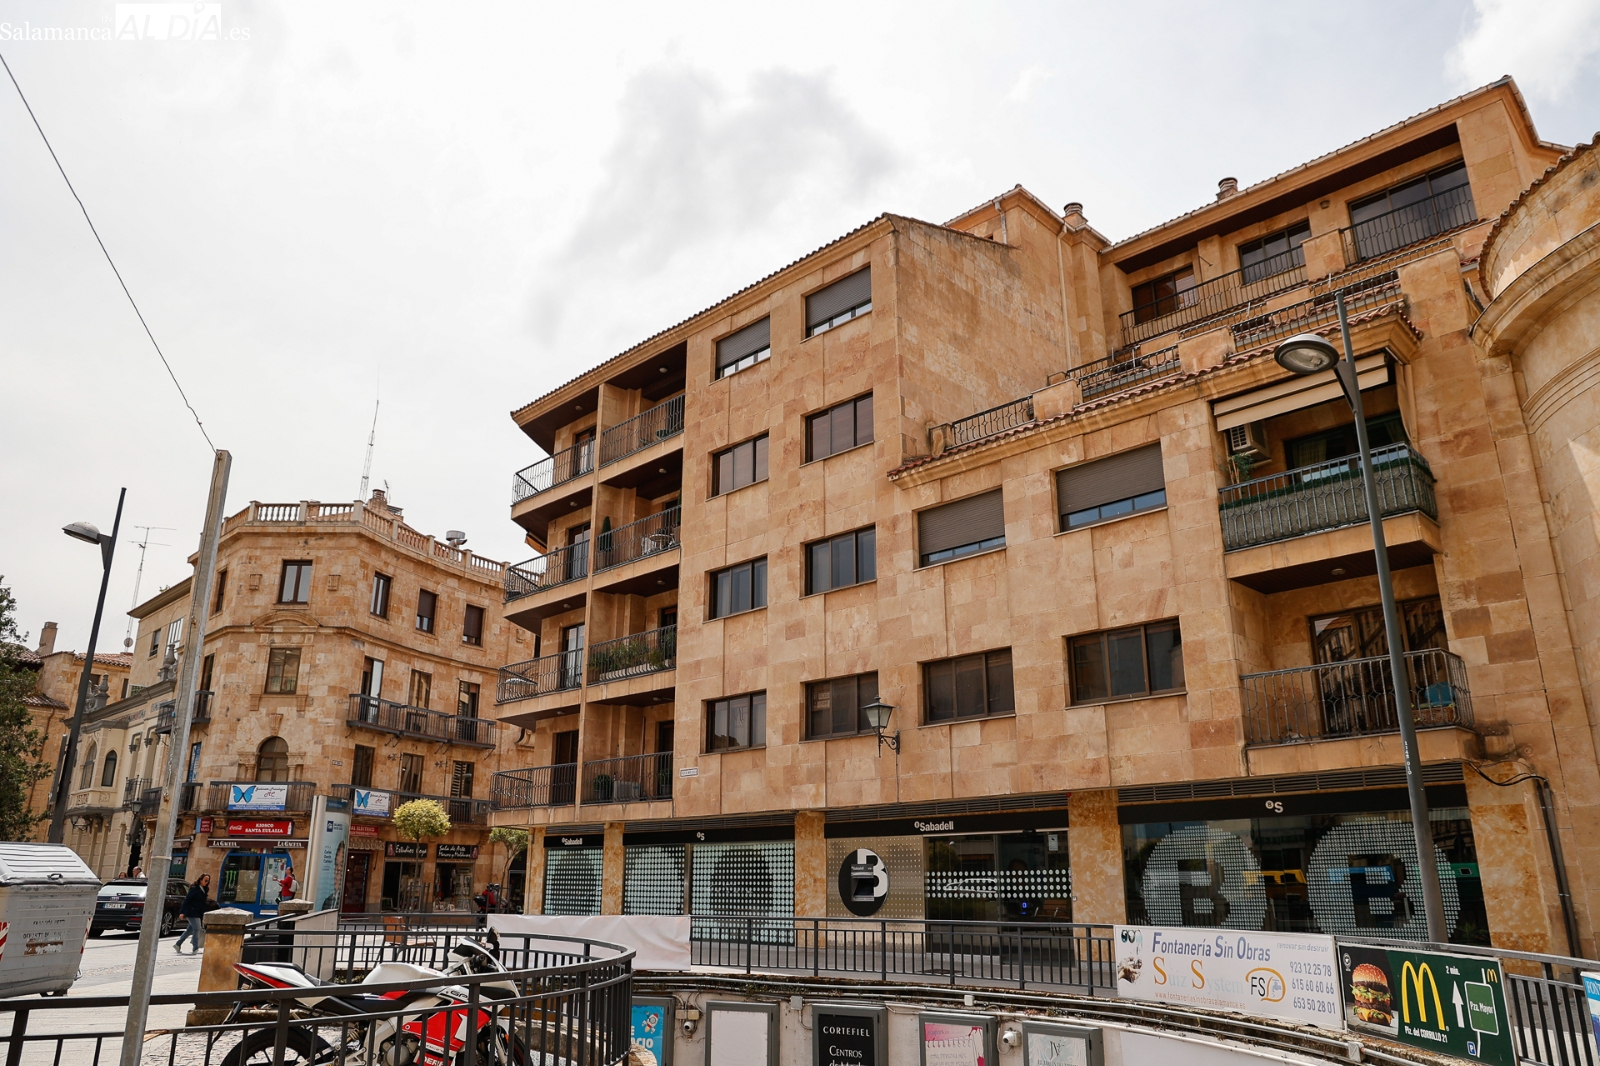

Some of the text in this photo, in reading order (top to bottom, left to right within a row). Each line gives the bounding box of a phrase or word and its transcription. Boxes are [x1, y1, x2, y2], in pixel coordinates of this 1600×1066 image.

[915, 821, 955, 832] Sabadell
[1152, 932, 1271, 962] Fontanería Sin Obras
[1277, 942, 1298, 950] renovar
[1307, 943, 1329, 953] destruir
[1153, 956, 1243, 995] Suiz System
[1290, 961, 1332, 977] 923 12 25 78
[1445, 965, 1461, 976] 2 min.
[1291, 978, 1335, 994] 615 60 60 66
[1293, 997, 1336, 1014] 653 50 28 01
[1469, 1000, 1494, 1015] Pza. Mayor
[822, 1026, 870, 1037] CORTEFIEL
[1420, 1029, 1441, 1041] CORRILLO
[1440, 1034, 1448, 1043] 21
